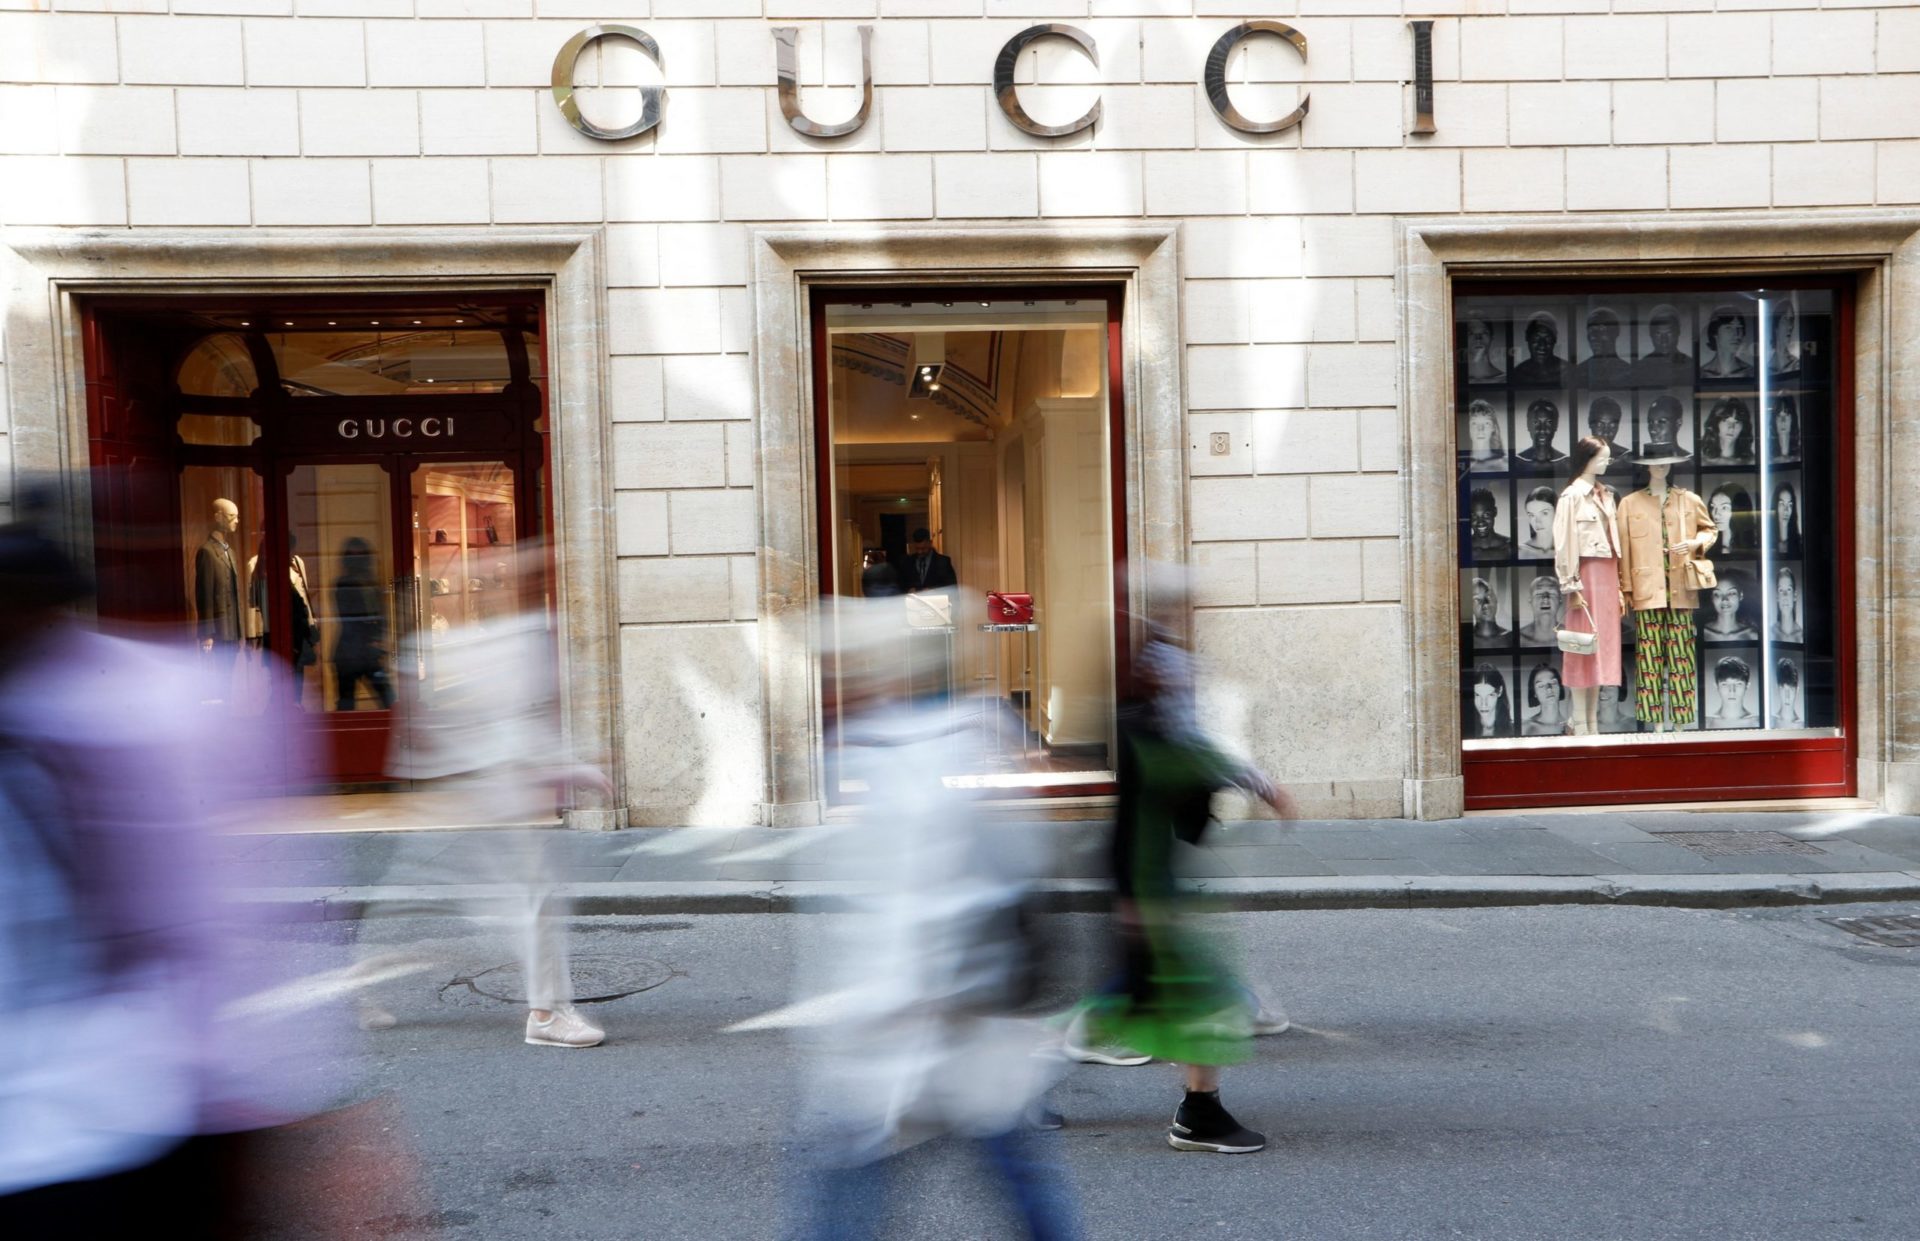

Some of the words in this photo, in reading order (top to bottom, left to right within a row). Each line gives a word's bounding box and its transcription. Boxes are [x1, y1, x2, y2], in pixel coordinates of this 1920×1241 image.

[551, 21, 1437, 140] GUCCI
[338, 417, 454, 438] GUCCI
[1215, 435, 1226, 453] 8
